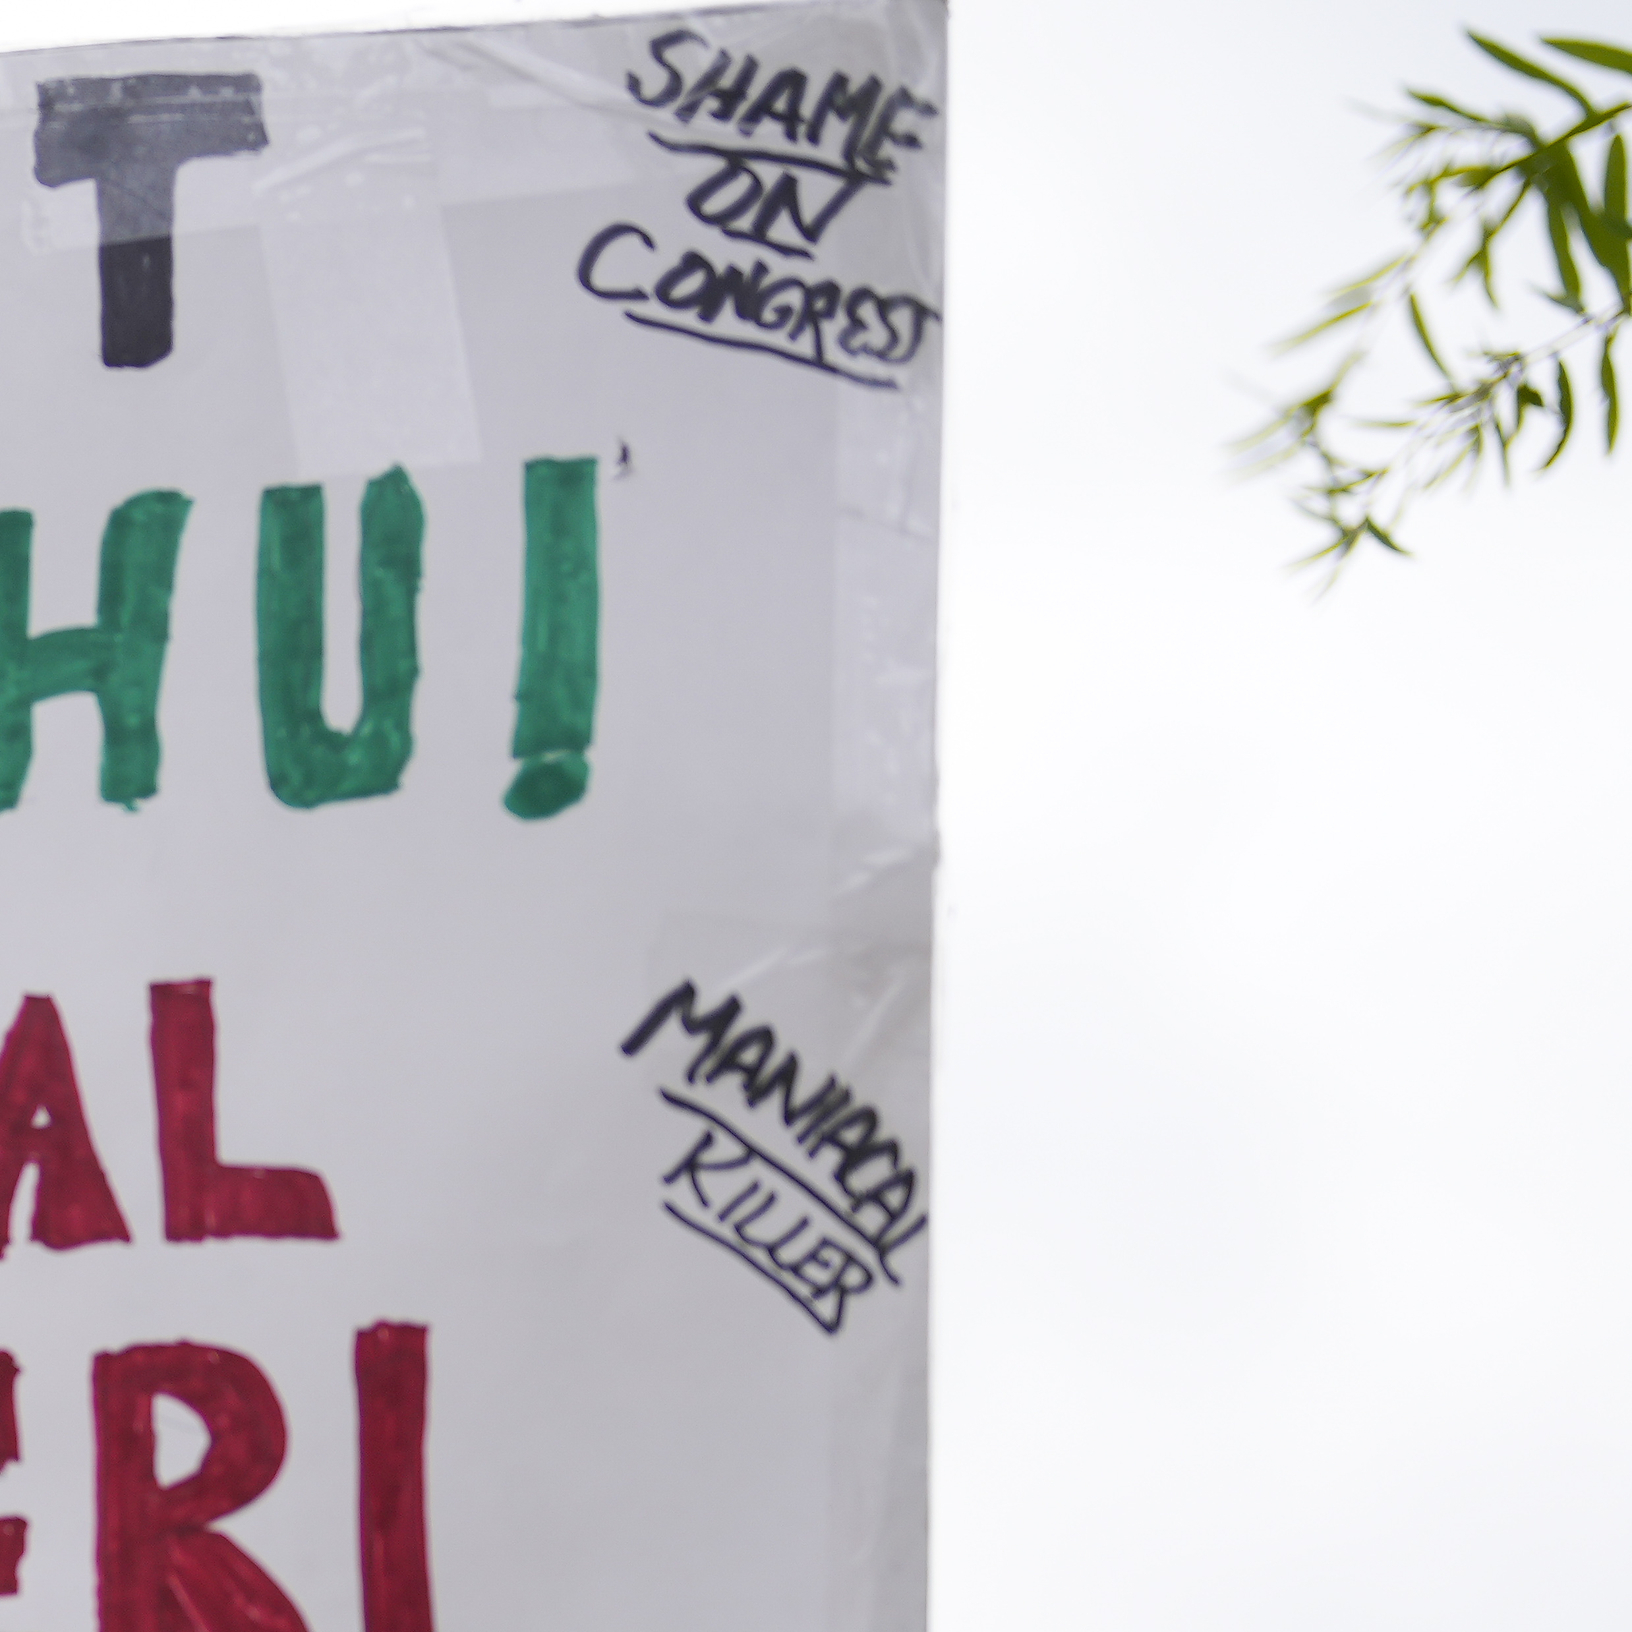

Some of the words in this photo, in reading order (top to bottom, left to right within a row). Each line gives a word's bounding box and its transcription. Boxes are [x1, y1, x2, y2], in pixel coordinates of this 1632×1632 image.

[625, 28, 940, 173] SHAME
[684, 166, 866, 244] ON
[620, 977, 929, 1286] MANIACAL
[661, 1128, 876, 1338] KILLER
